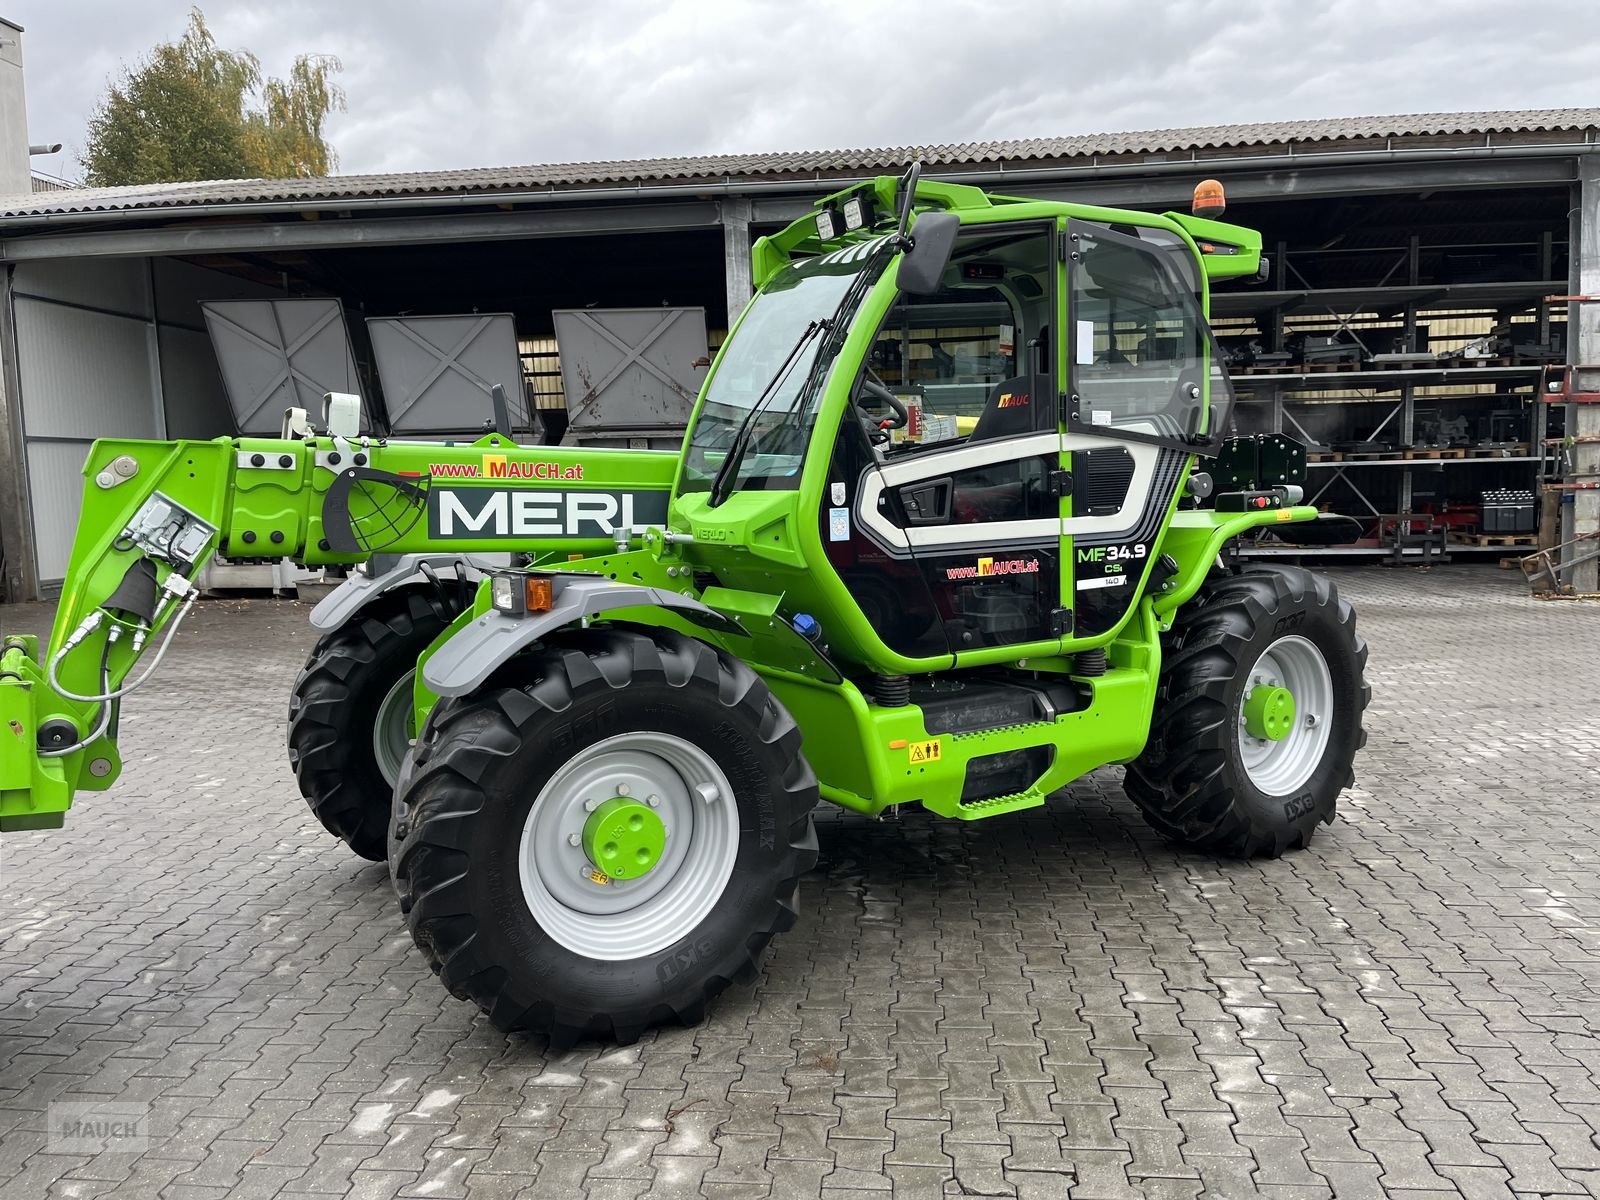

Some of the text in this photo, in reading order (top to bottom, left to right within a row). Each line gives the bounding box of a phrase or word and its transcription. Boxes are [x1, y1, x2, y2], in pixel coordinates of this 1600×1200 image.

[429, 461, 583, 480] www.MAUCH.at
[439, 490, 666, 535] MERL
[946, 559, 1039, 580] www.MAUCH.at
[1105, 577, 1120, 585] 140
[1284, 793, 1315, 823] BKT
[657, 938, 719, 985] BKT
